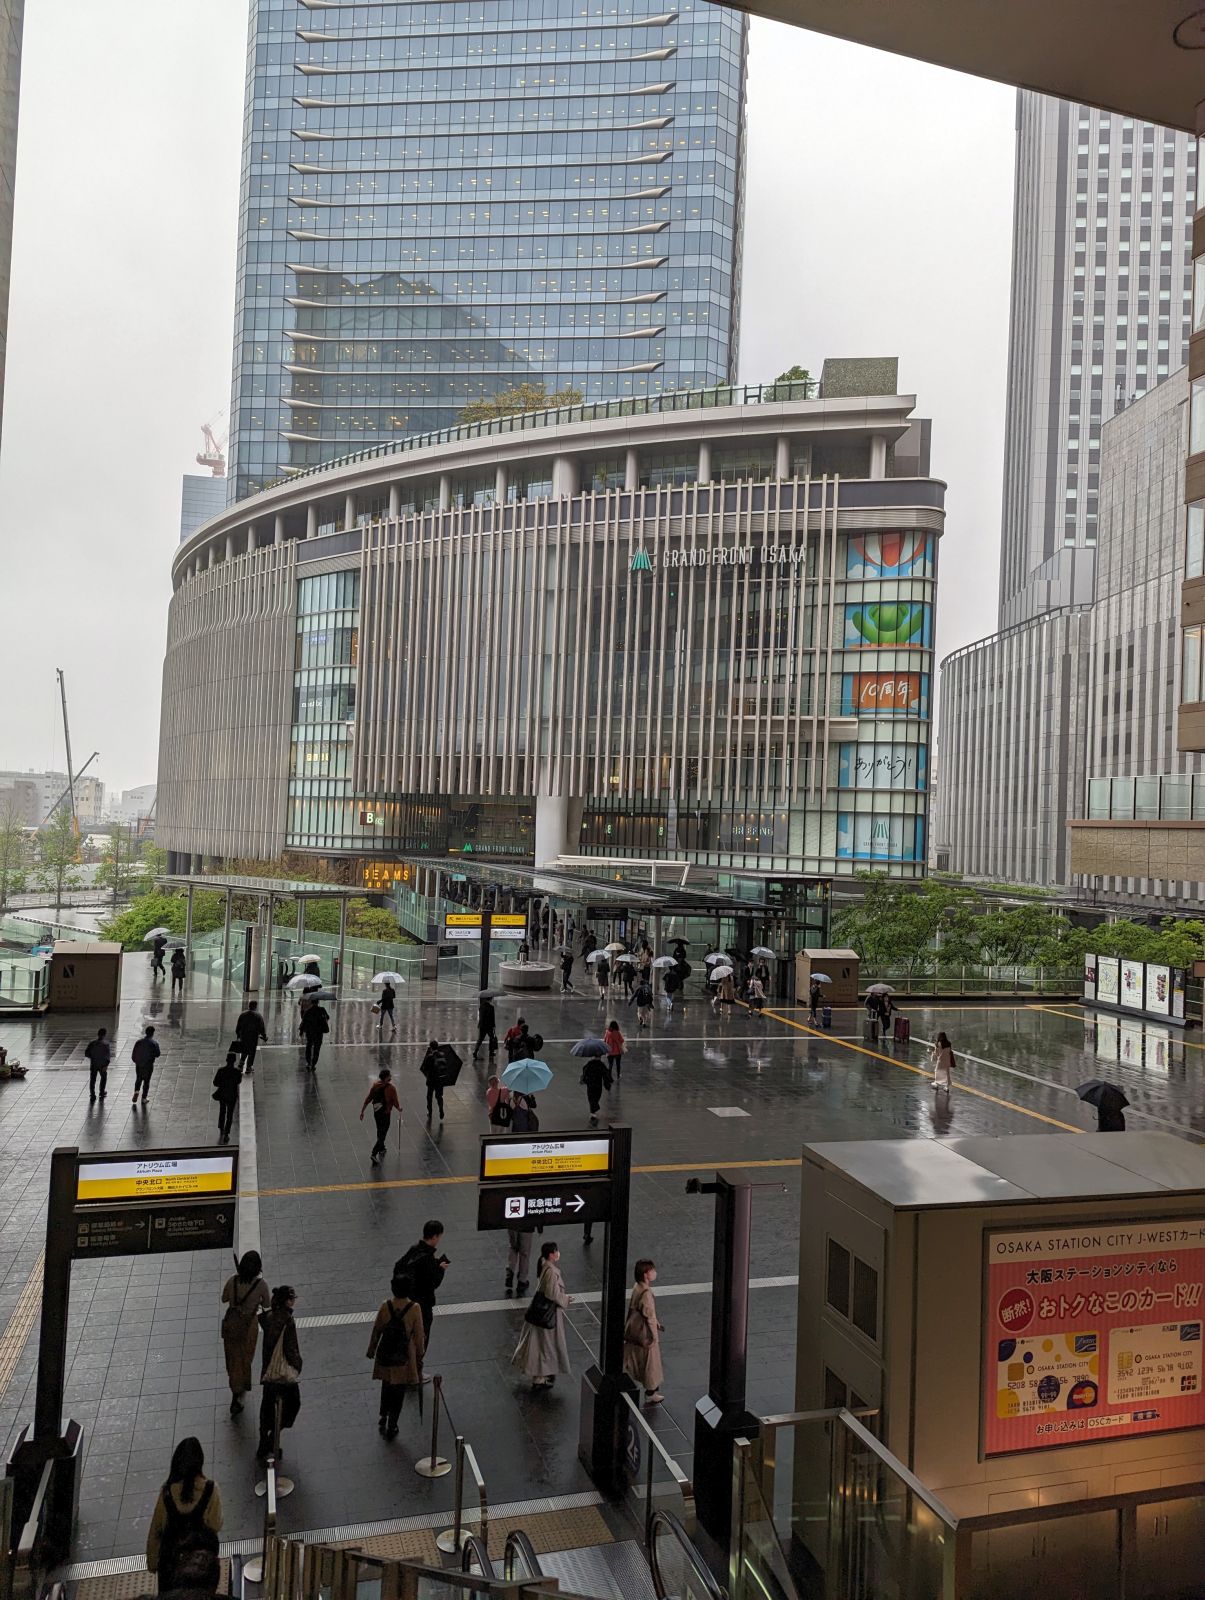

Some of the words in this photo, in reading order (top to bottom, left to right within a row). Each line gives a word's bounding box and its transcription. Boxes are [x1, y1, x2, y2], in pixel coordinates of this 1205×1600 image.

[662, 548, 707, 569] GRAND
[711, 545, 756, 566] FRONT
[760, 544, 807, 564] OSAKA
[860, 680, 912, 705] 10周年
[362, 869, 409, 881] BEAMS
[136, 1160, 178, 1170] アトリウム広場
[136, 1178, 163, 1186] 中央北口
[527, 1197, 562, 1209] 阪急電車
[996, 1241, 1043, 1255] OSAKA
[1048, 1236, 1101, 1251] STATION
[1107, 1233, 1134, 1247] CITY
[1026, 1259, 1178, 1284] 大阪ステーションシティなら
[1039, 1284, 1202, 1319] おトクなこのカード!!
[1036, 1420, 1085, 1434] お申し込みは
[1088, 1415, 1125, 1427] OSCカード
